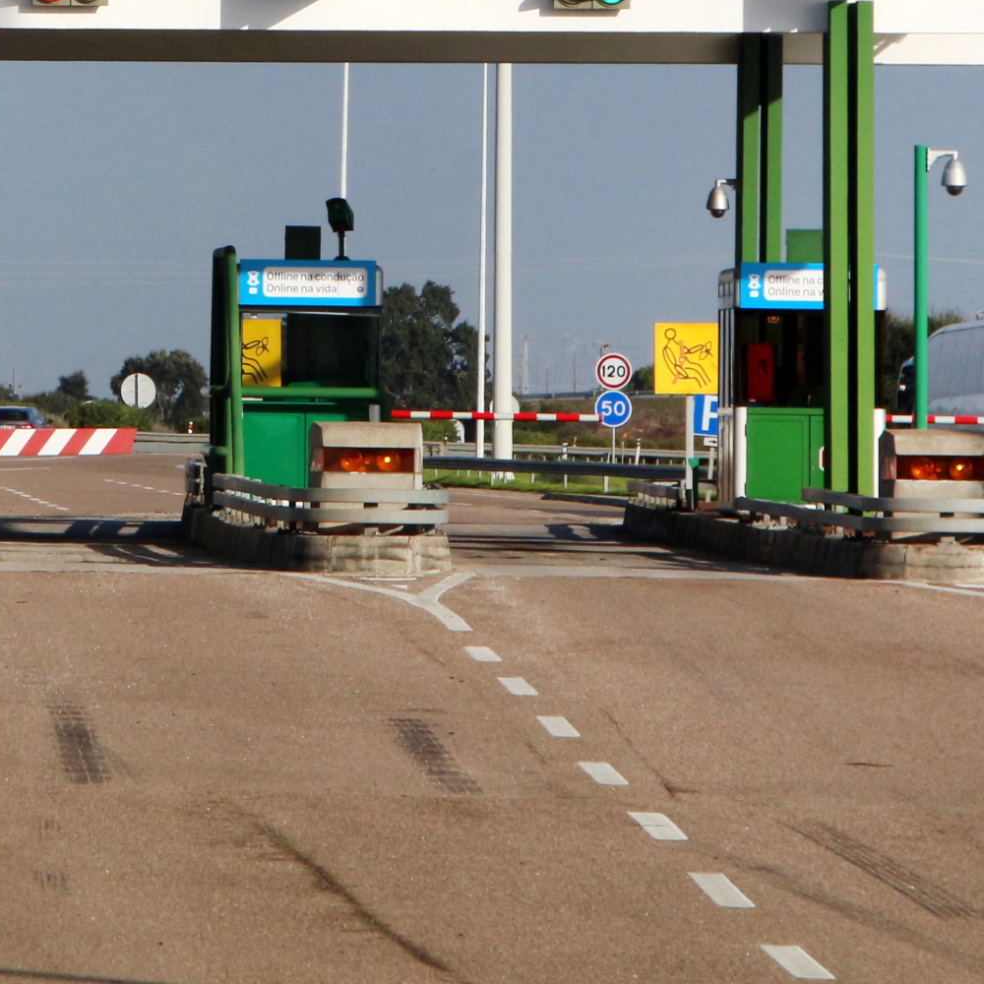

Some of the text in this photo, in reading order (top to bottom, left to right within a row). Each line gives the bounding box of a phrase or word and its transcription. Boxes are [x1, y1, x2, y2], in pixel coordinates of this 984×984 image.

[266, 271, 299, 281] Offline
[301, 273, 313, 281] na
[768, 275, 801, 285] Offline
[803, 277, 815, 285] na
[266, 283, 337, 293] Online na vida
[768, 286, 801, 297] Online
[803, 288, 816, 297] na
[602, 365, 626, 378] 120
[601, 401, 626, 416] 50
